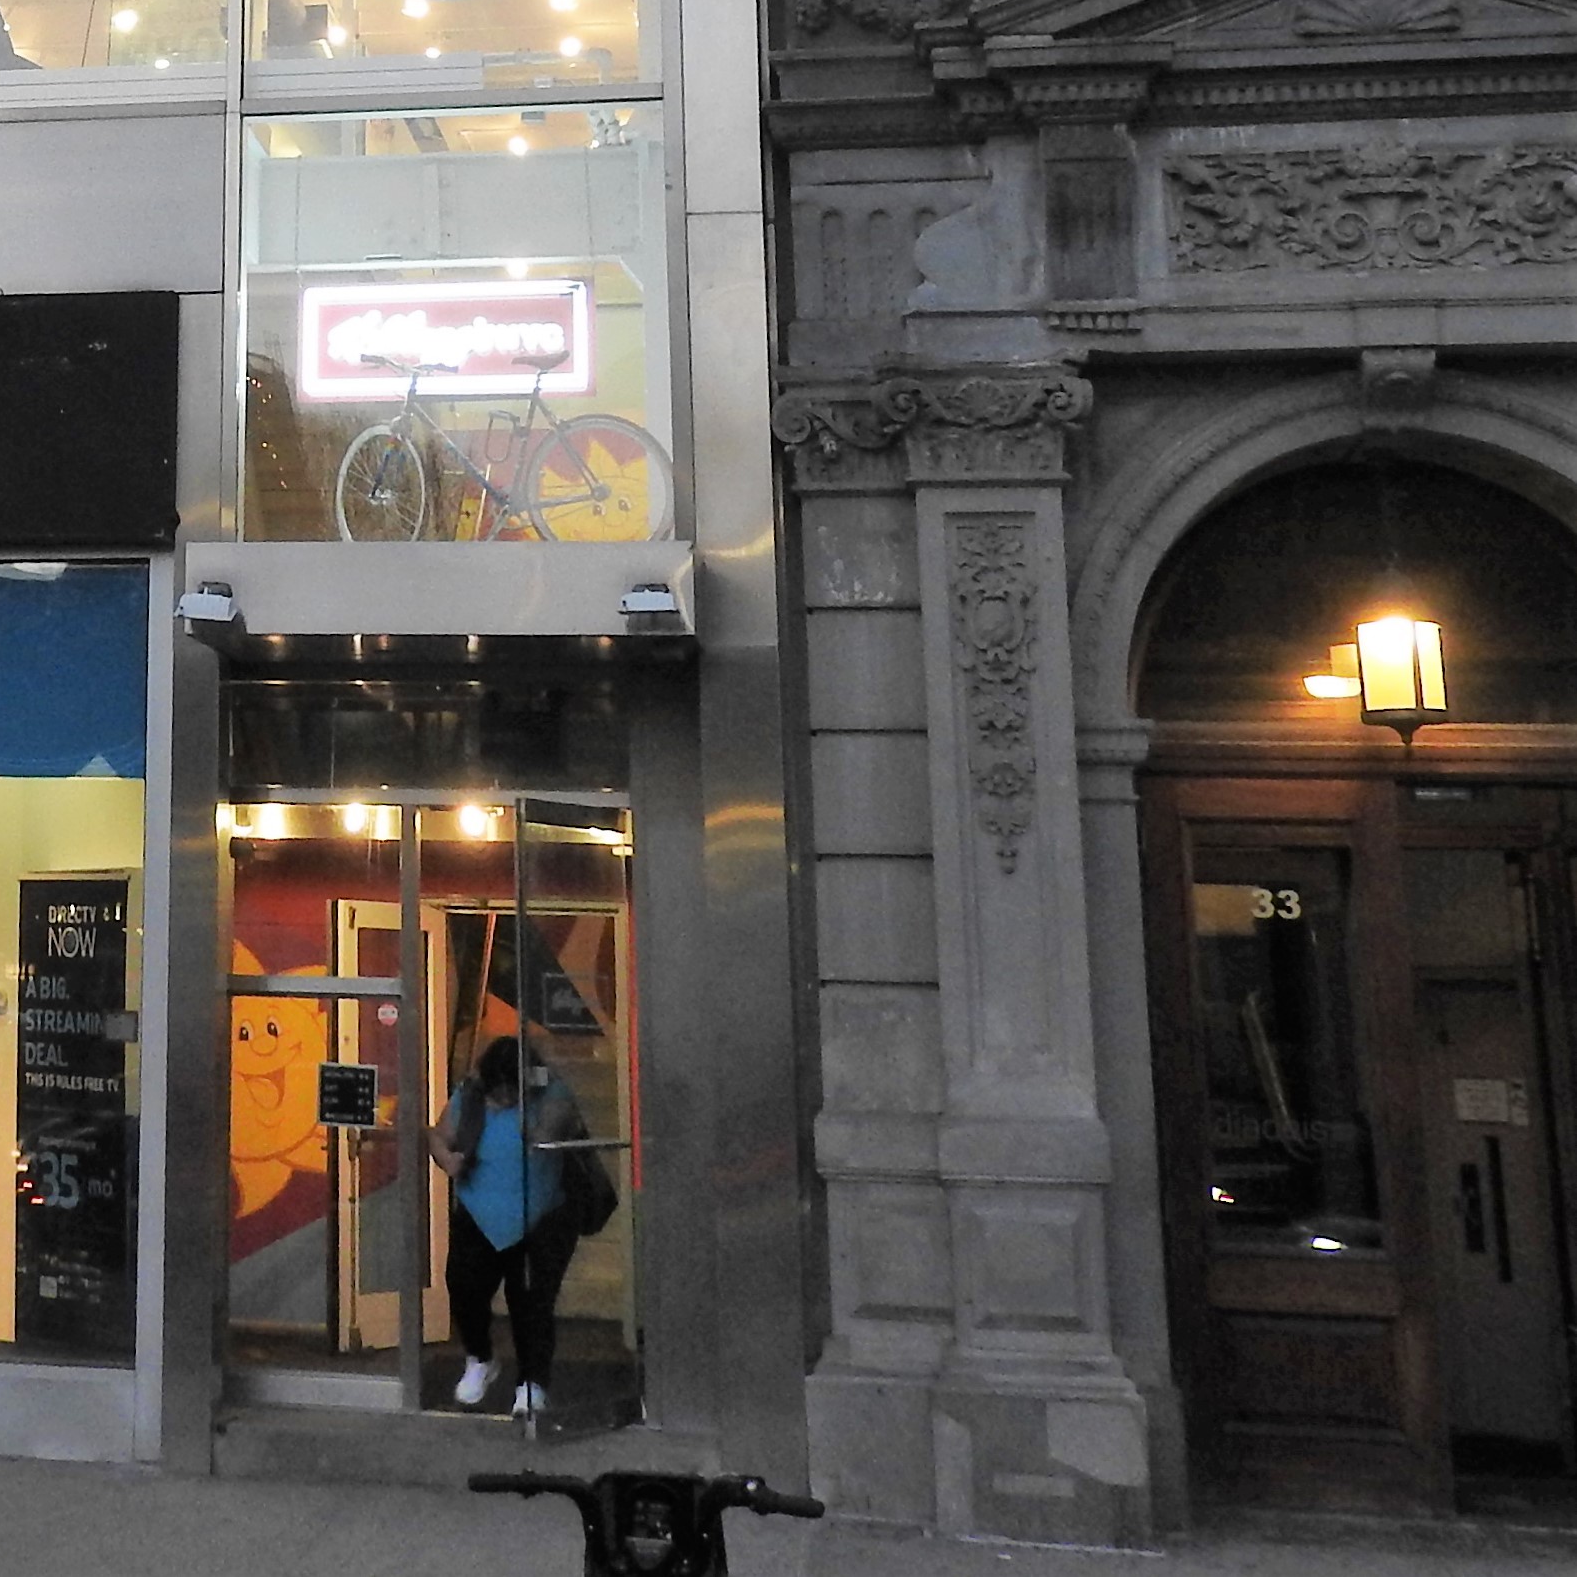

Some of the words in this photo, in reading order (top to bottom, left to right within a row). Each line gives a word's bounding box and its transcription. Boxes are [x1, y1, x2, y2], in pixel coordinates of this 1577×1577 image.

[1250, 888, 1302, 920] 33
[47, 927, 97, 960] NOW
[25, 1008, 105, 1037] STREAMIN
